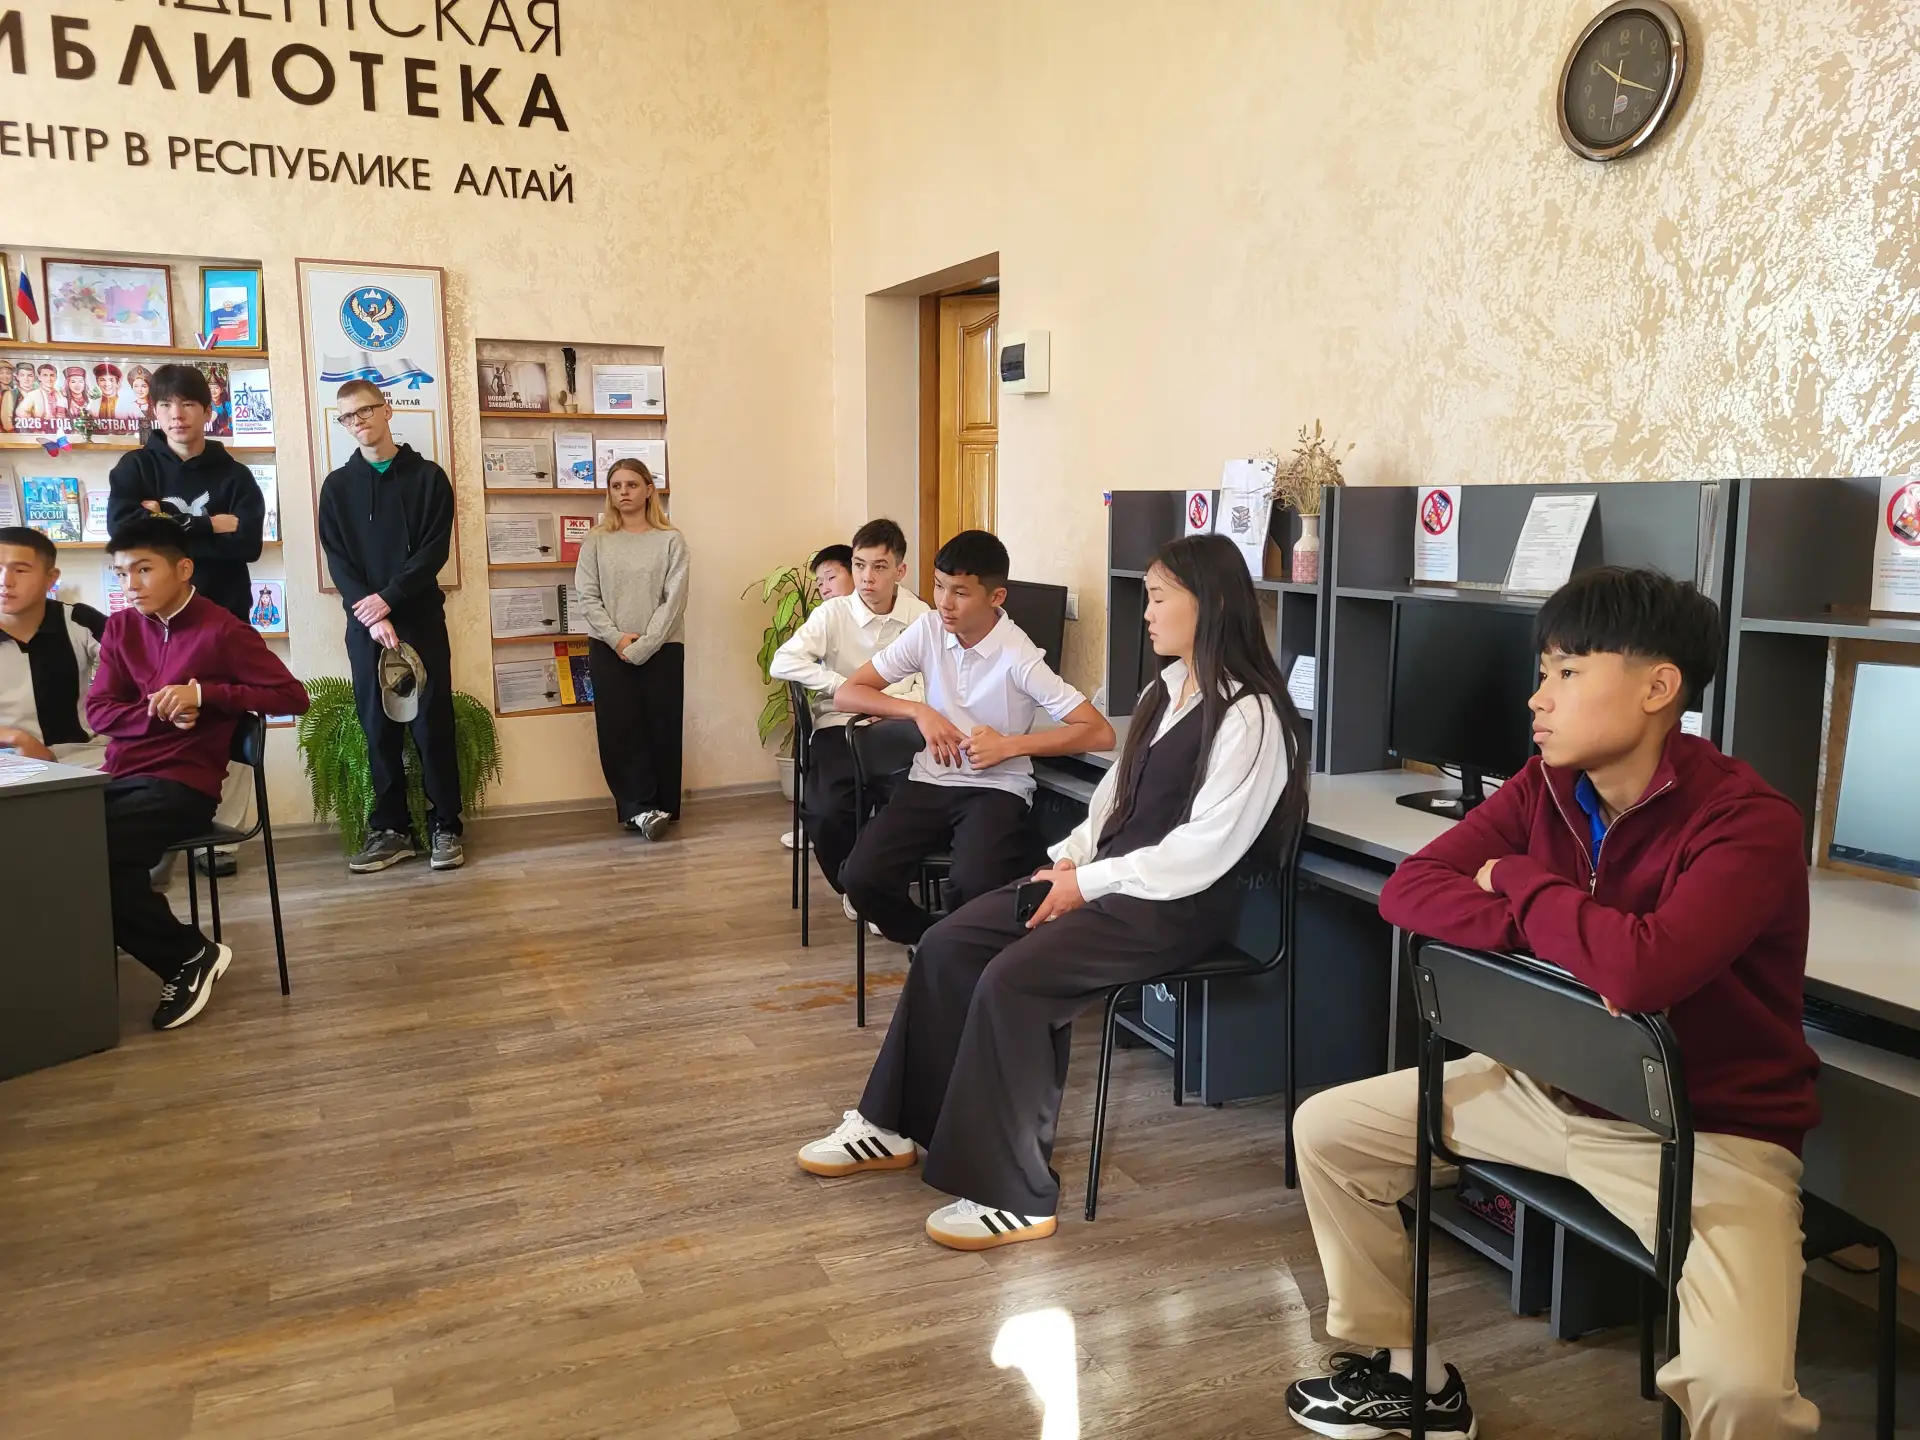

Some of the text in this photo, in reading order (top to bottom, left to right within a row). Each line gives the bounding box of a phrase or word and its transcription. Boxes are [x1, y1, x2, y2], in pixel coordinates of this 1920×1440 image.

[1584, 85, 1592, 98] 9
[1588, 104, 1596, 120] 8
[124, 131, 149, 166] В
[168, 135, 431, 191] РЕСПУБЛИКЕ
[454, 163, 574, 204] АЛТАЙ
[234, 393, 248, 406] 20
[235, 406, 248, 418] 26
[15, 417, 41, 429] 2026
[50, 418, 72, 431] ГОД
[30, 510, 64, 520] РОССИЯ
